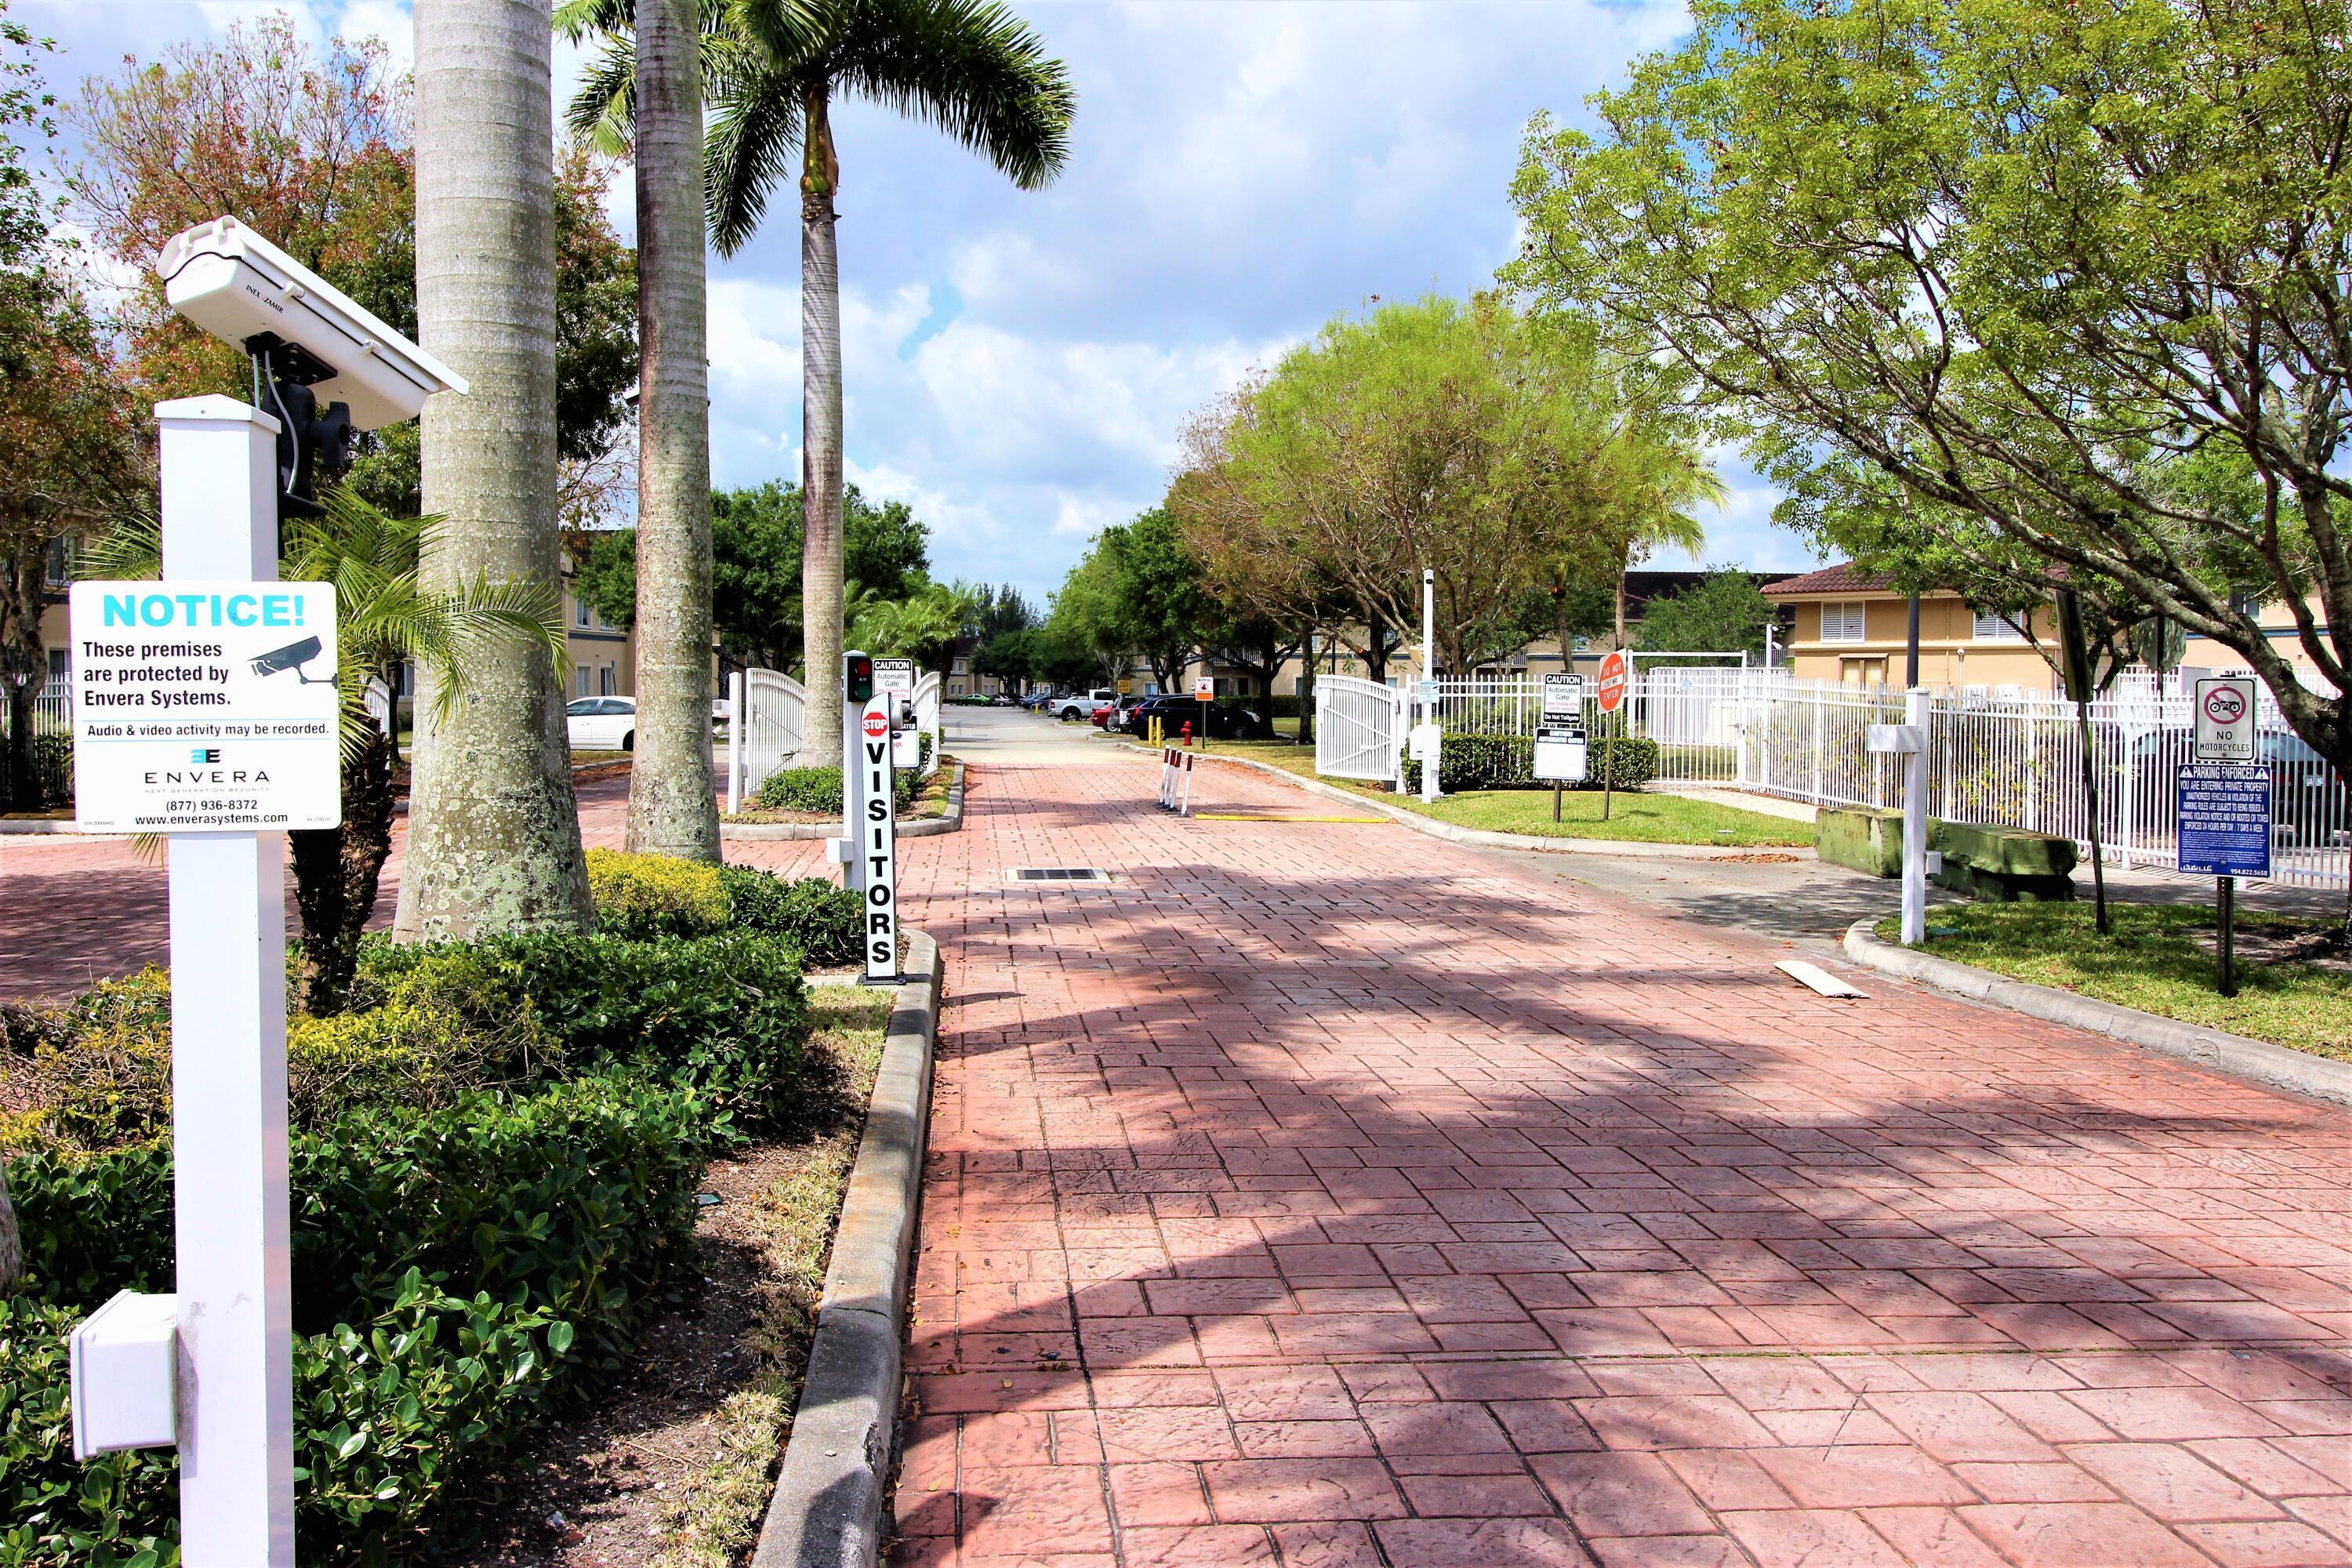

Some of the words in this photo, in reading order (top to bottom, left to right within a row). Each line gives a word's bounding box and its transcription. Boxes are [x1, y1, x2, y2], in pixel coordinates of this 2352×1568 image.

[246, 285, 261, 298] INEX
[263, 296, 284, 314] ZAMIR
[103, 594, 304, 627] NOTICE!
[83, 641, 135, 658] These
[141, 641, 222, 660] premises
[875, 661, 909, 670] CAUTION
[1602, 668, 1610, 677] DO
[1612, 662, 1622, 673] NOT
[84, 669, 112, 682] are
[118, 666, 204, 684] protected
[209, 666, 229, 684] by
[1546, 675, 1581, 684] CAUTION
[85, 690, 144, 706] Envera
[151, 689, 231, 709] Systems.
[1604, 688, 1618, 701] ENTER
[88, 724, 122, 736] Audio
[127, 724, 136, 735] &
[140, 724, 172, 736] video
[176, 724, 220, 738] activity
[226, 725, 250, 737] may
[255, 724, 268, 735] be
[273, 724, 329, 735] recorded.
[863, 719, 887, 730] STOP
[2216, 731, 2233, 740] NO
[2199, 743, 2249, 752] MOTORCYCLES
[144, 771, 270, 784] ENVERA
[2193, 766, 2220, 779] PARKING
[2222, 767, 2255, 780] ENFORCED
[2180, 781, 2190, 790] YOU
[2190, 781, 2200, 790] ARE
[2201, 781, 2223, 791] ENTERING
[2225, 782, 2243, 792] PRIVATE
[2244, 782, 2269, 792] PROPERTY
[2211, 793, 2227, 801] VEHICLES
[165, 801, 196, 812] (877)
[201, 800, 258, 811] 936-8372
[2183, 801, 2197, 811] PARKING
[2198, 802, 2209, 811] RULES
[2217, 803, 2231, 811] SUBJECT
[2232, 803, 2238, 811] TO
[2238, 804, 2248, 812] BEING
[2249, 804, 2261, 812] ISSUED
[135, 813, 289, 826] www.enverasystems.com
[2180, 811, 2194, 820] PARKING
[2184, 822, 2201, 830] ENFORCED
[866, 742, 891, 964] VISITORS
